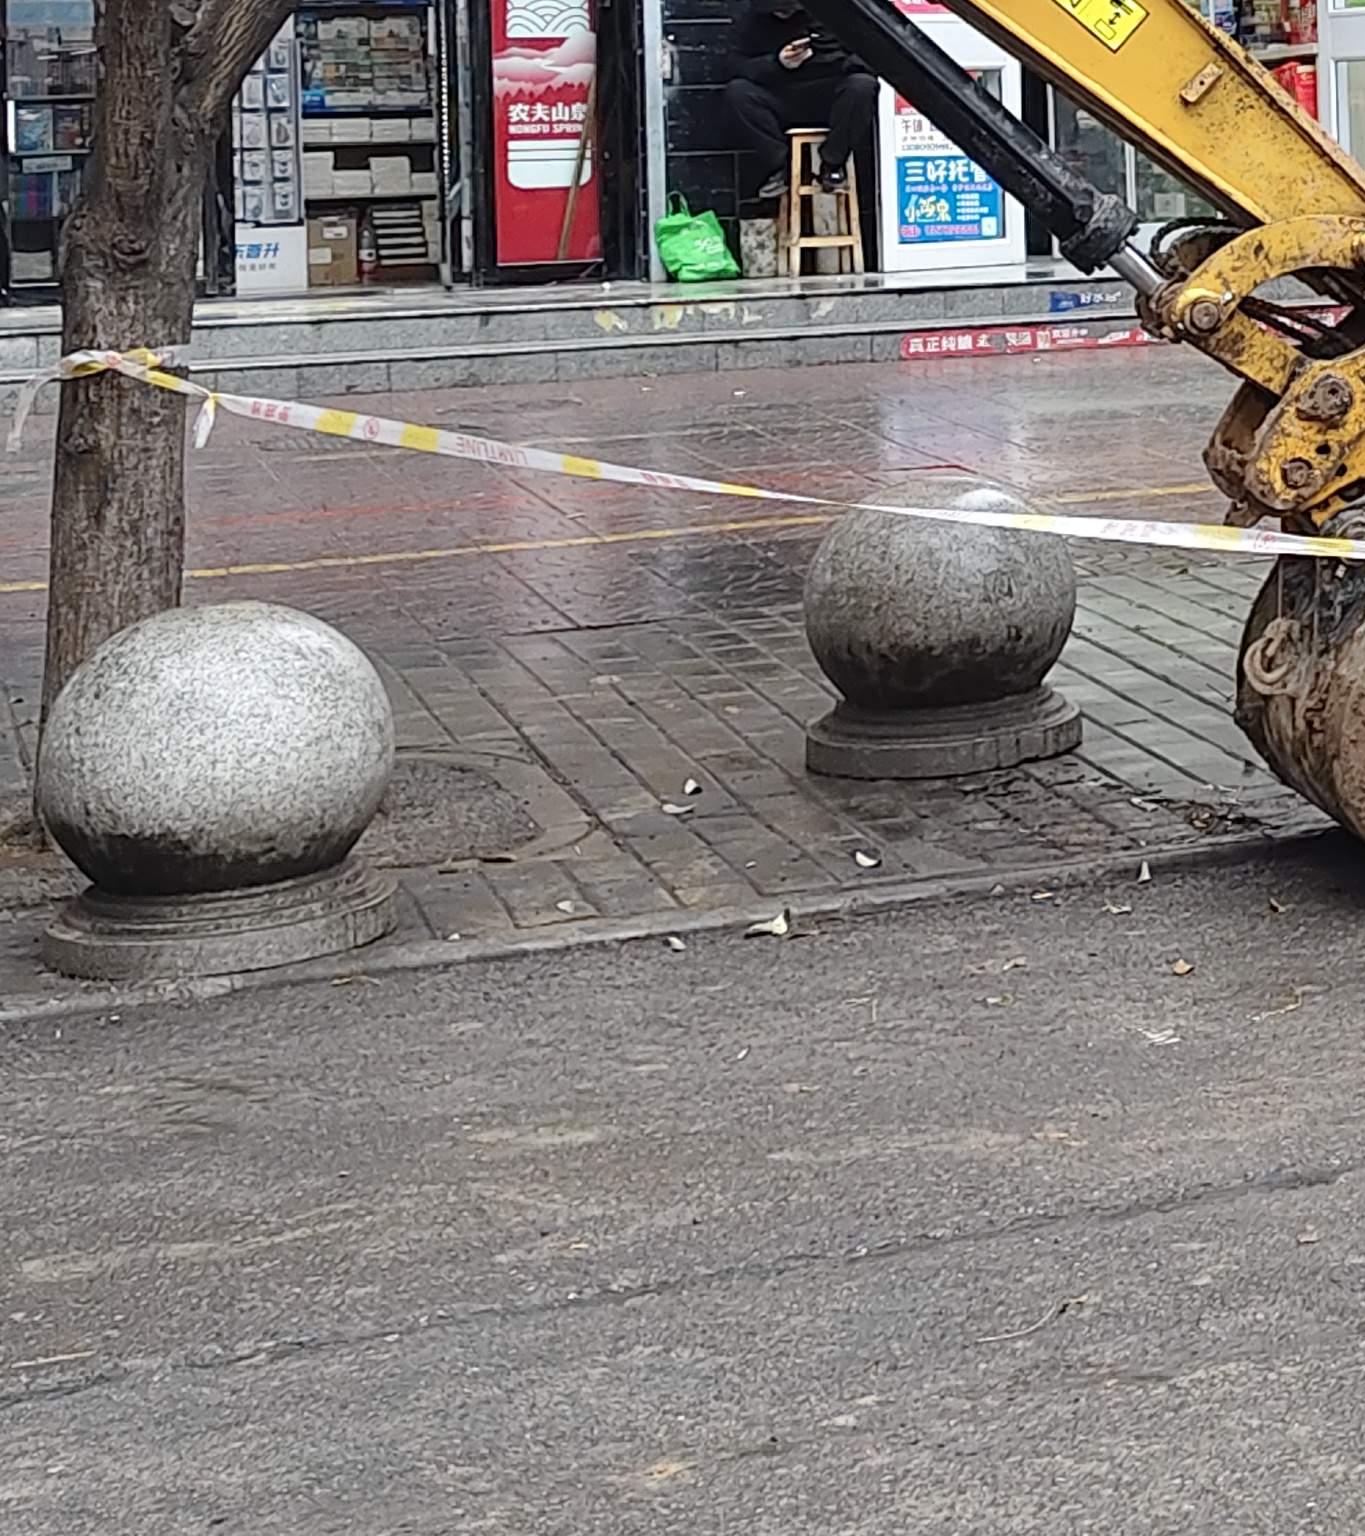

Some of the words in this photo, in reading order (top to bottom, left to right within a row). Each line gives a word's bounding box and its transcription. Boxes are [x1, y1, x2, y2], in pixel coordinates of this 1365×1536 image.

[508, 101, 588, 122] 农夫山泉
[457, 435, 528, 466] LIMITLINE
